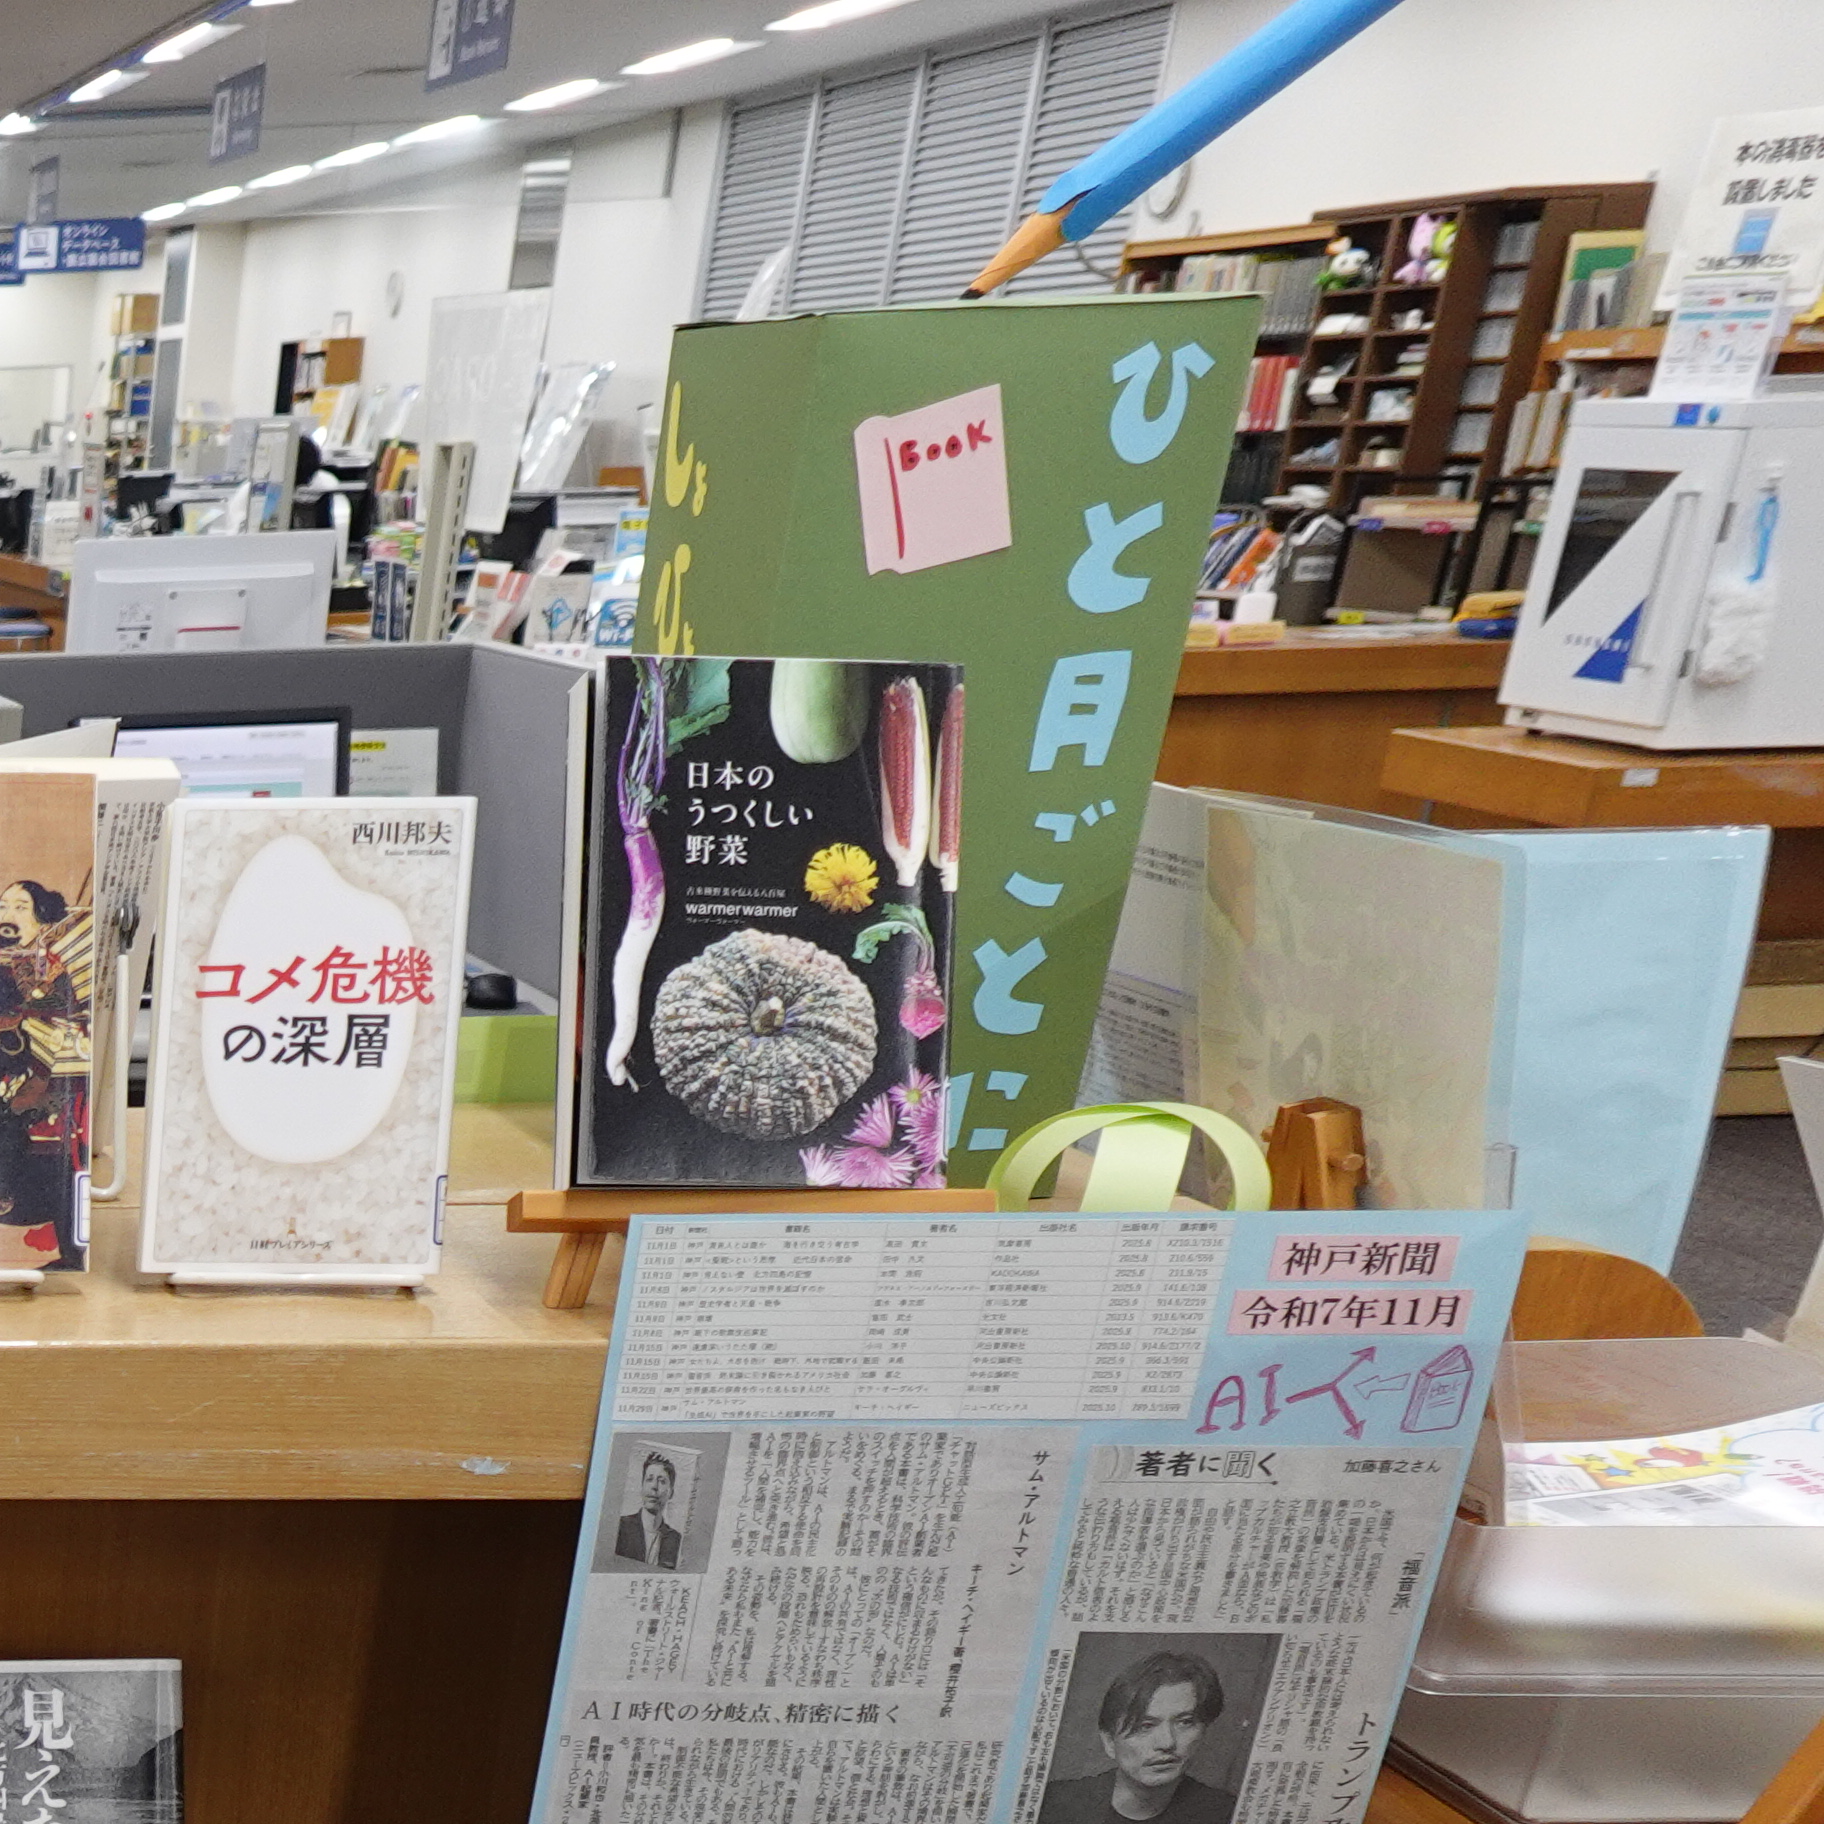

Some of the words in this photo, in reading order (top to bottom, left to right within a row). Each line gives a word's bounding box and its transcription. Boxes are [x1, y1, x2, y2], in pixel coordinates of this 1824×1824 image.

[946, 338, 1216, 1153] ひと月ごとに
[687, 761, 775, 791] 日本の
[687, 798, 814, 828] うつくしい
[352, 820, 453, 847] 西川邦夫
[685, 833, 749, 866] 野菜
[685, 902, 799, 918] warmerwarmer
[194, 944, 436, 1006] コメ危機
[222, 1013, 392, 1069] の深層
[1283, 1240, 1441, 1277] 神戸新聞
[1239, 1294, 1464, 1330] 令和7年11月
[1196, 1363, 1284, 1435] AI
[1135, 1447, 1278, 1481] 著者に聞く
[1342, 1457, 1443, 1476] 加藤喜之さん
[1004, 1449, 1055, 1581] サム・アルトマン
